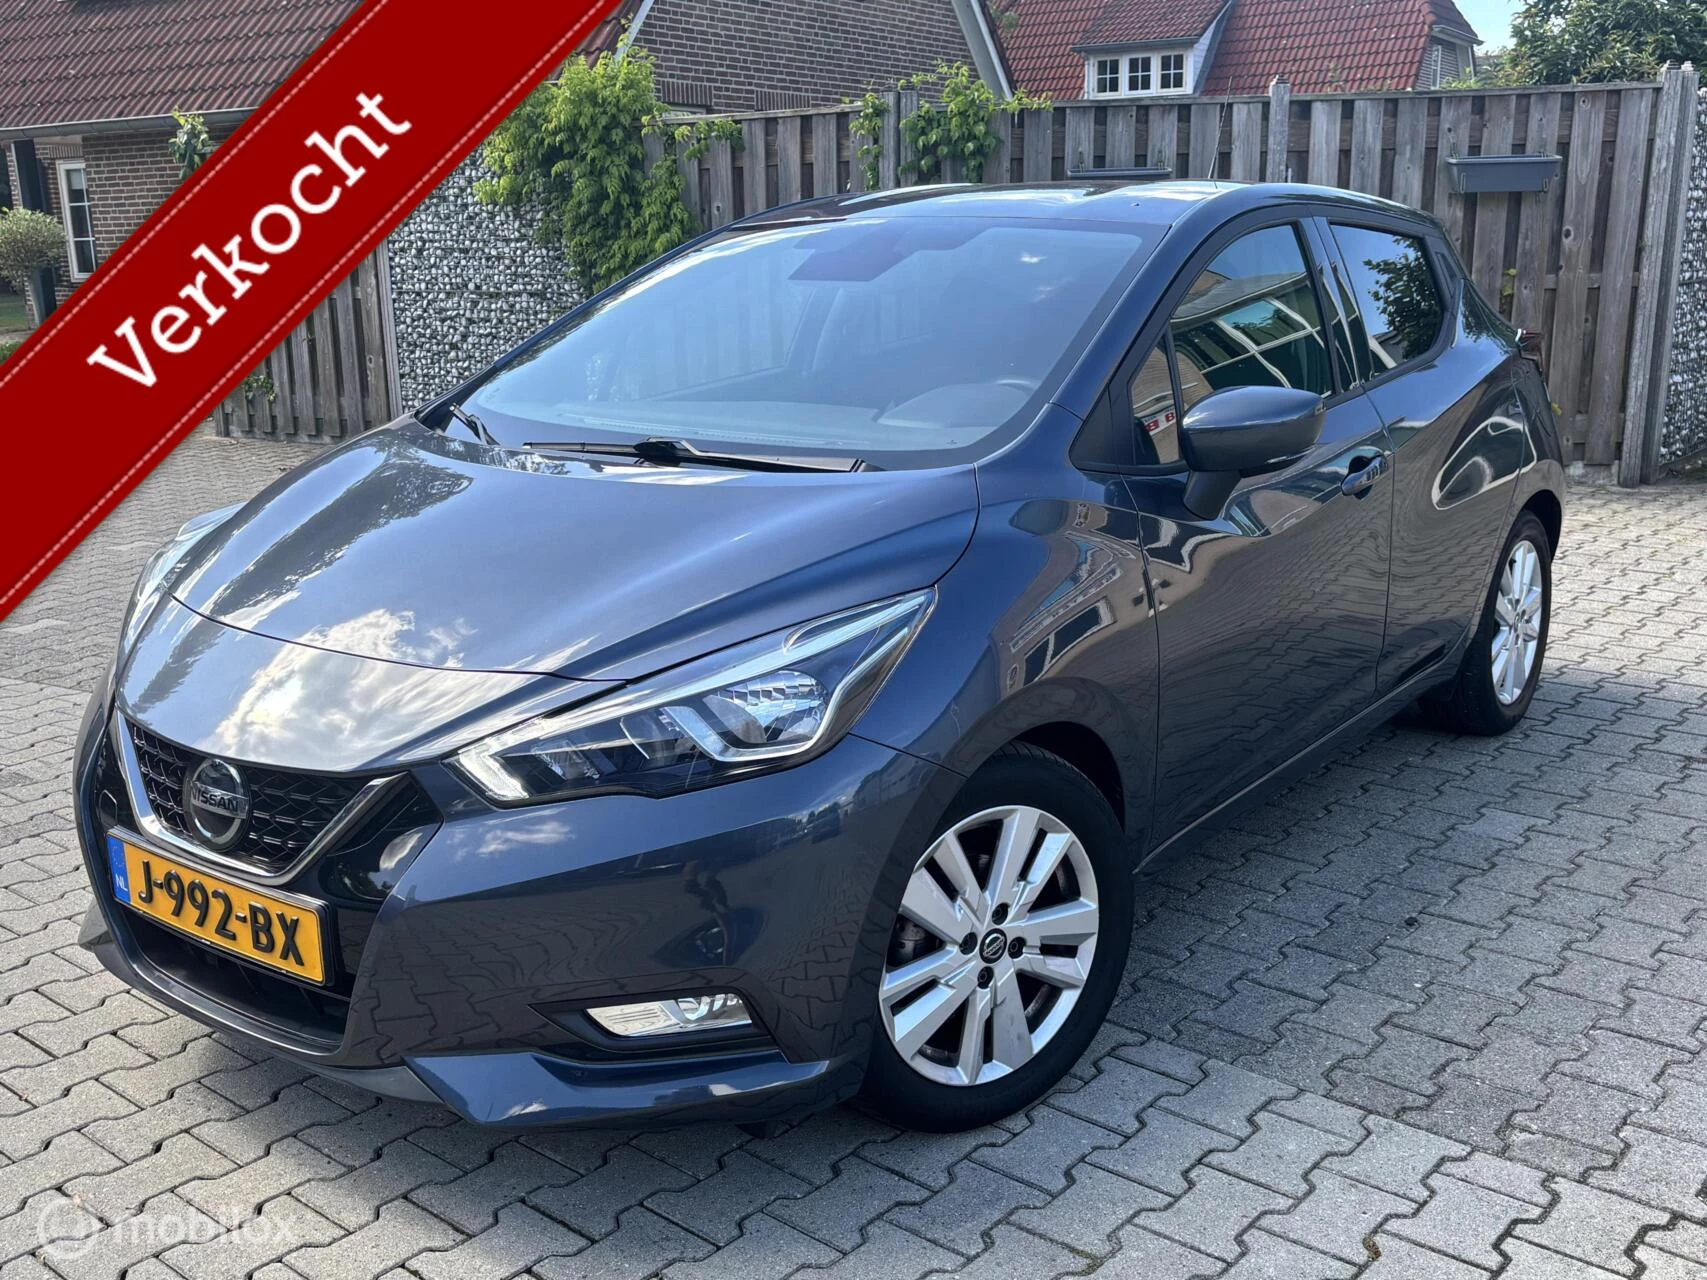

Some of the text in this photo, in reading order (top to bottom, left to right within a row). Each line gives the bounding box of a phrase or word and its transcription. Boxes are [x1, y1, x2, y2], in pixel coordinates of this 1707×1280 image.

[190, 781, 239, 812] NISSAN
[115, 874, 128, 892] NL
[138, 860, 304, 966] J-992-BX
